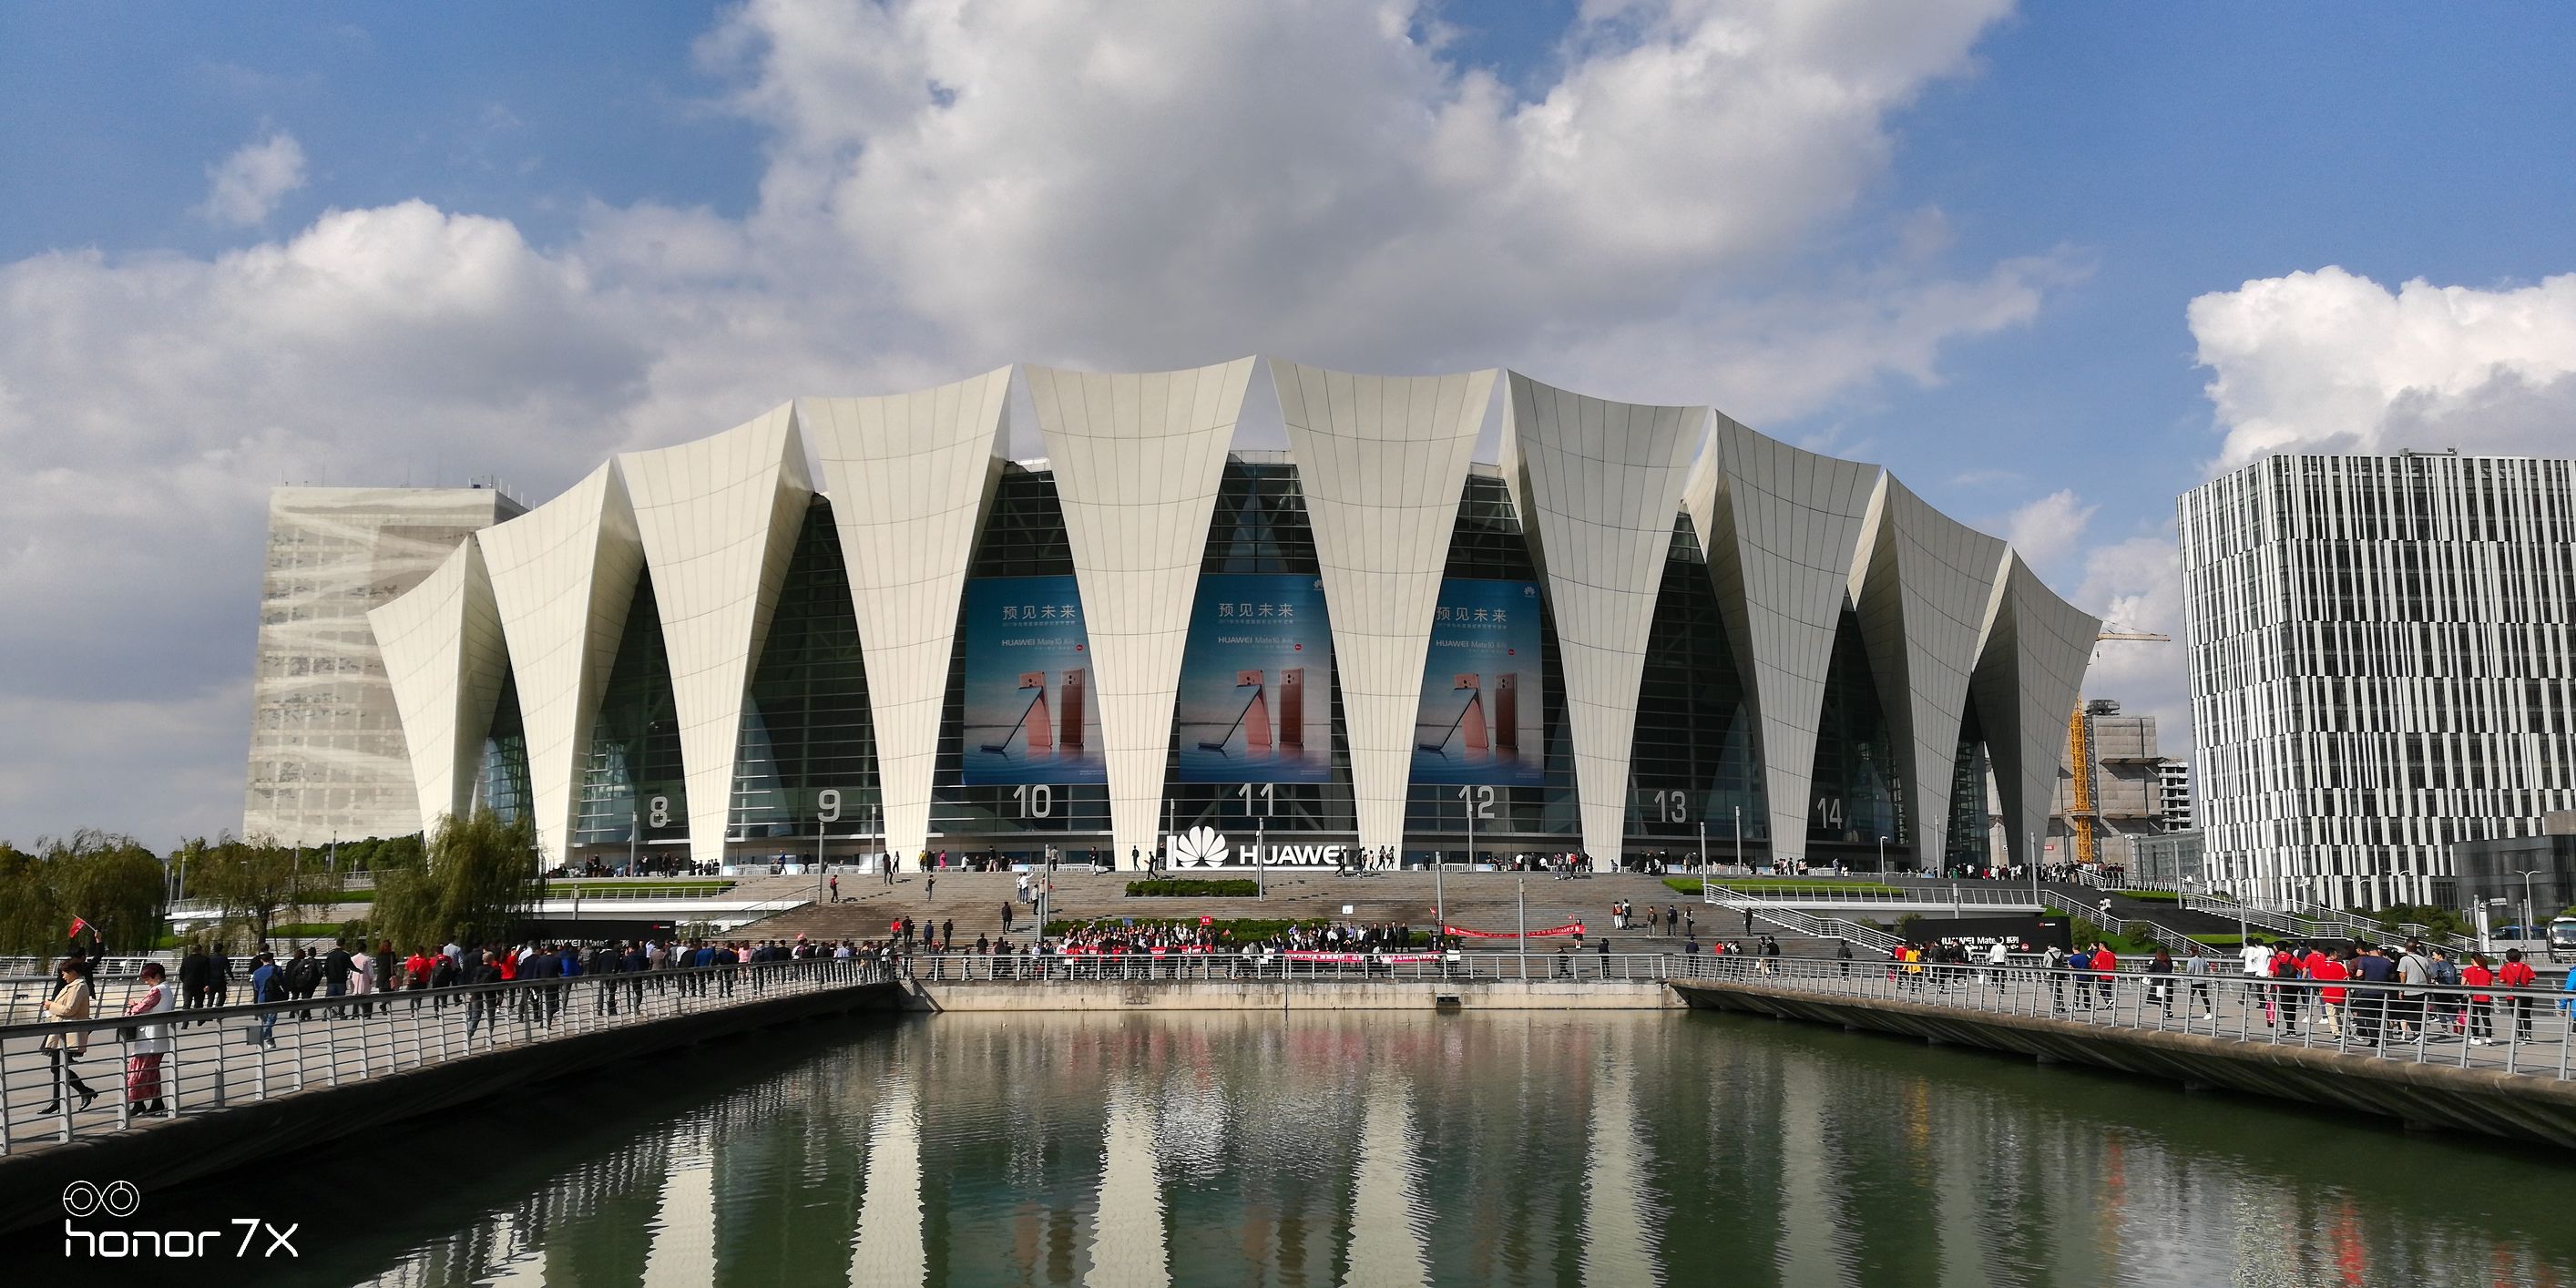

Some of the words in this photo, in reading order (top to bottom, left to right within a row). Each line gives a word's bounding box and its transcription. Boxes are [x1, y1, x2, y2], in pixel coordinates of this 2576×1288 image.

[1002, 604, 1076, 620] 预见未来
[1218, 602, 1294, 618] 预见未来
[1436, 607, 1508, 622] 预见未来
[1436, 639, 1469, 648] HUAWEI
[649, 796, 669, 829] 8
[817, 789, 842, 823] 9
[1013, 784, 1052, 818] 10
[1237, 782, 1274, 817] 11
[1457, 785, 1496, 819] 12
[1653, 790, 1687, 823] 13
[1816, 797, 1844, 830] 14
[1240, 845, 1347, 865] HUAWEI
